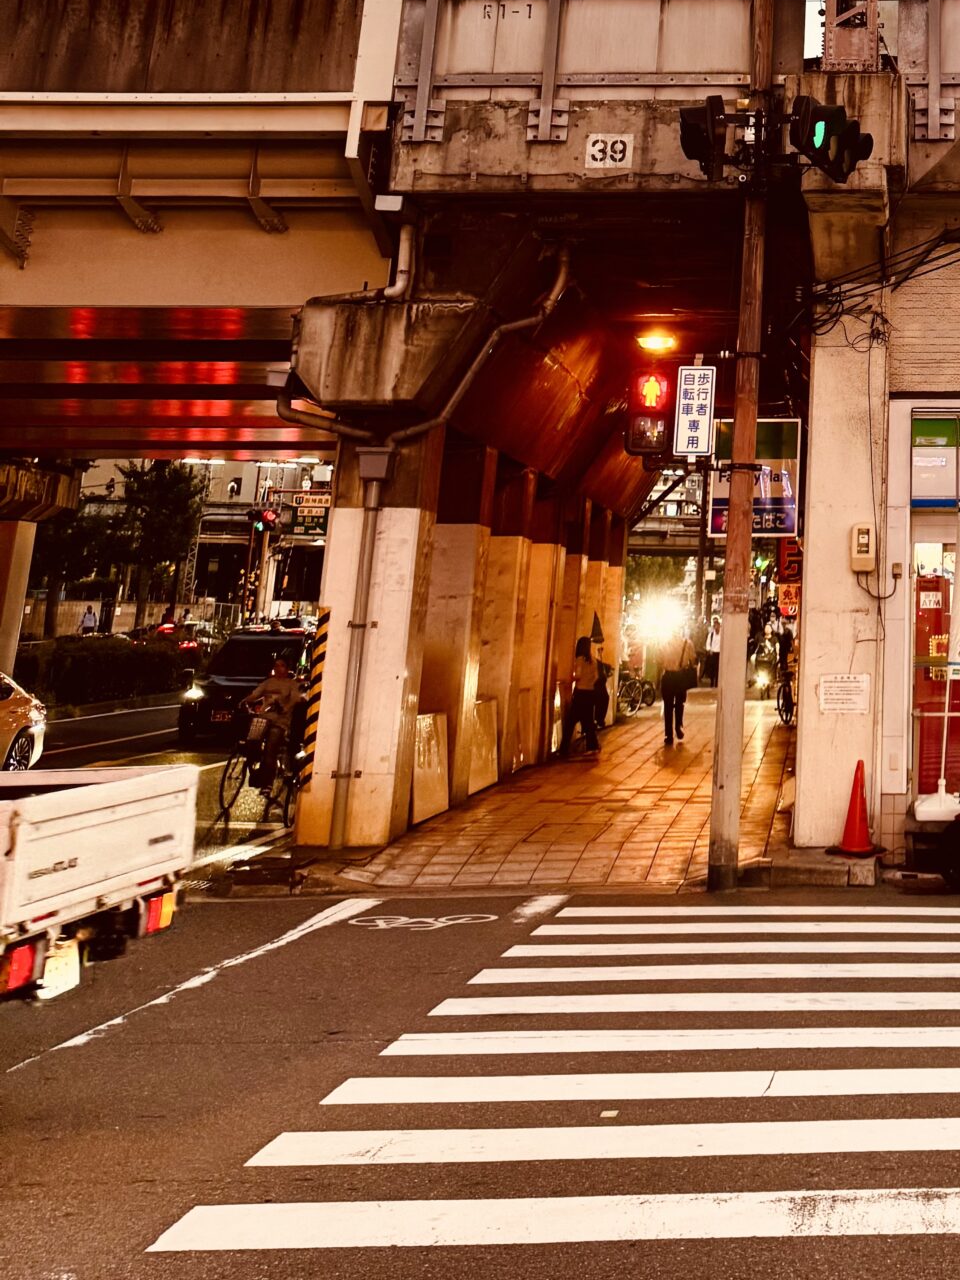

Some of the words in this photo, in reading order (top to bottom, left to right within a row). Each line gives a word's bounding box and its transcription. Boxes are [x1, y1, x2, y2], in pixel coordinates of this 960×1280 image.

[590, 138, 628, 163] 39
[681, 372, 695, 417] 自転車
[695, 372, 711, 416] 歩行者
[686, 419, 700, 449] 専用
[922, 599, 941, 608] ATM
